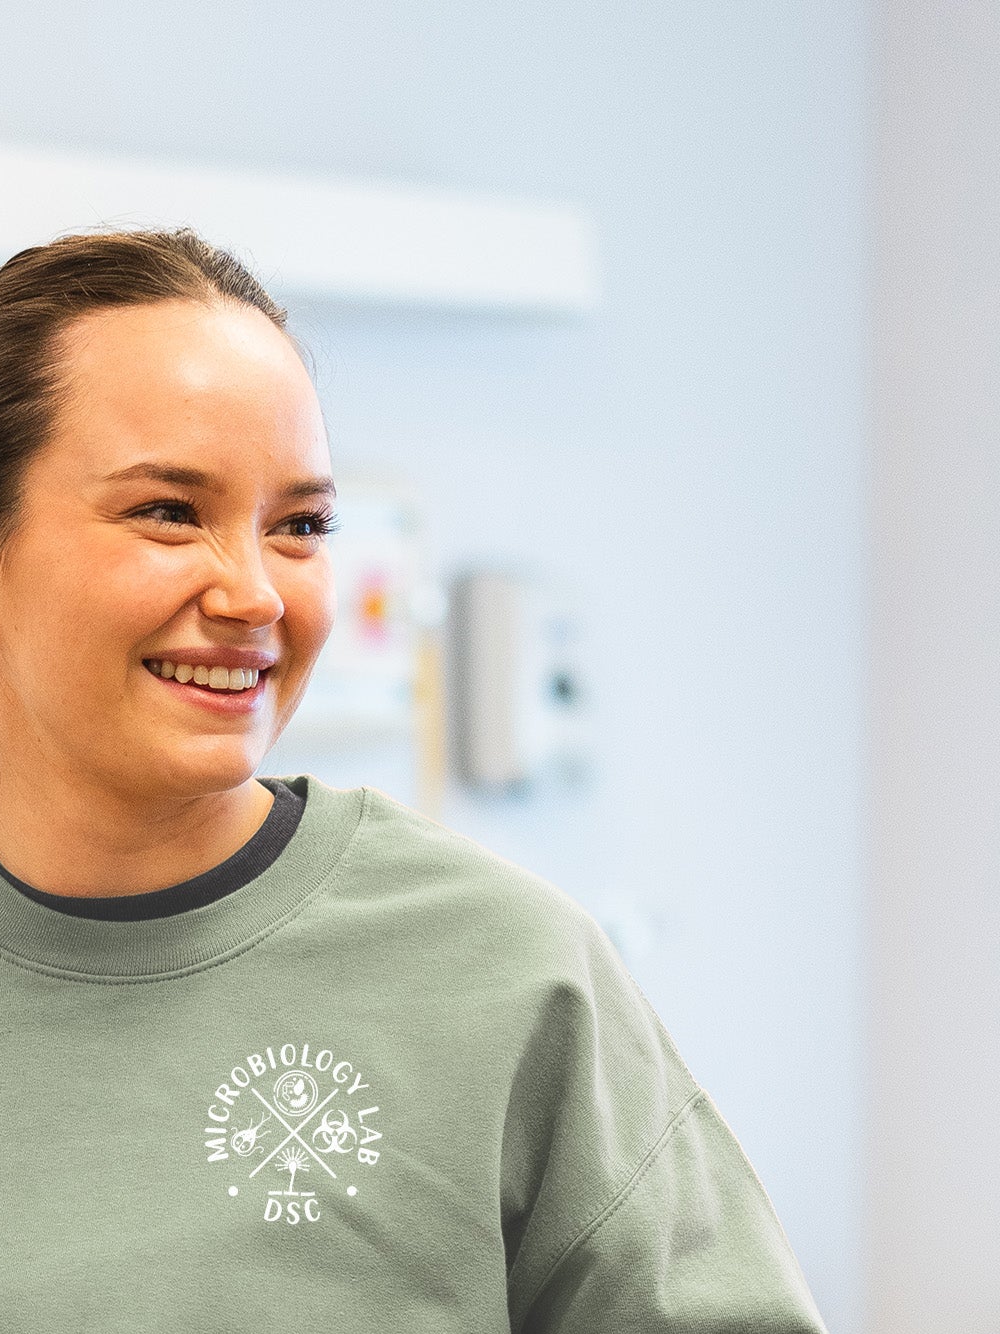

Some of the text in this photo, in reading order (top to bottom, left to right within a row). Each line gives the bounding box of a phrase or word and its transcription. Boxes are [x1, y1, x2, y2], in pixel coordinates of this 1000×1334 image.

[204, 1043, 383, 1165] MICROBIOLOGY LAB
[263, 1198, 321, 1225] DSC
